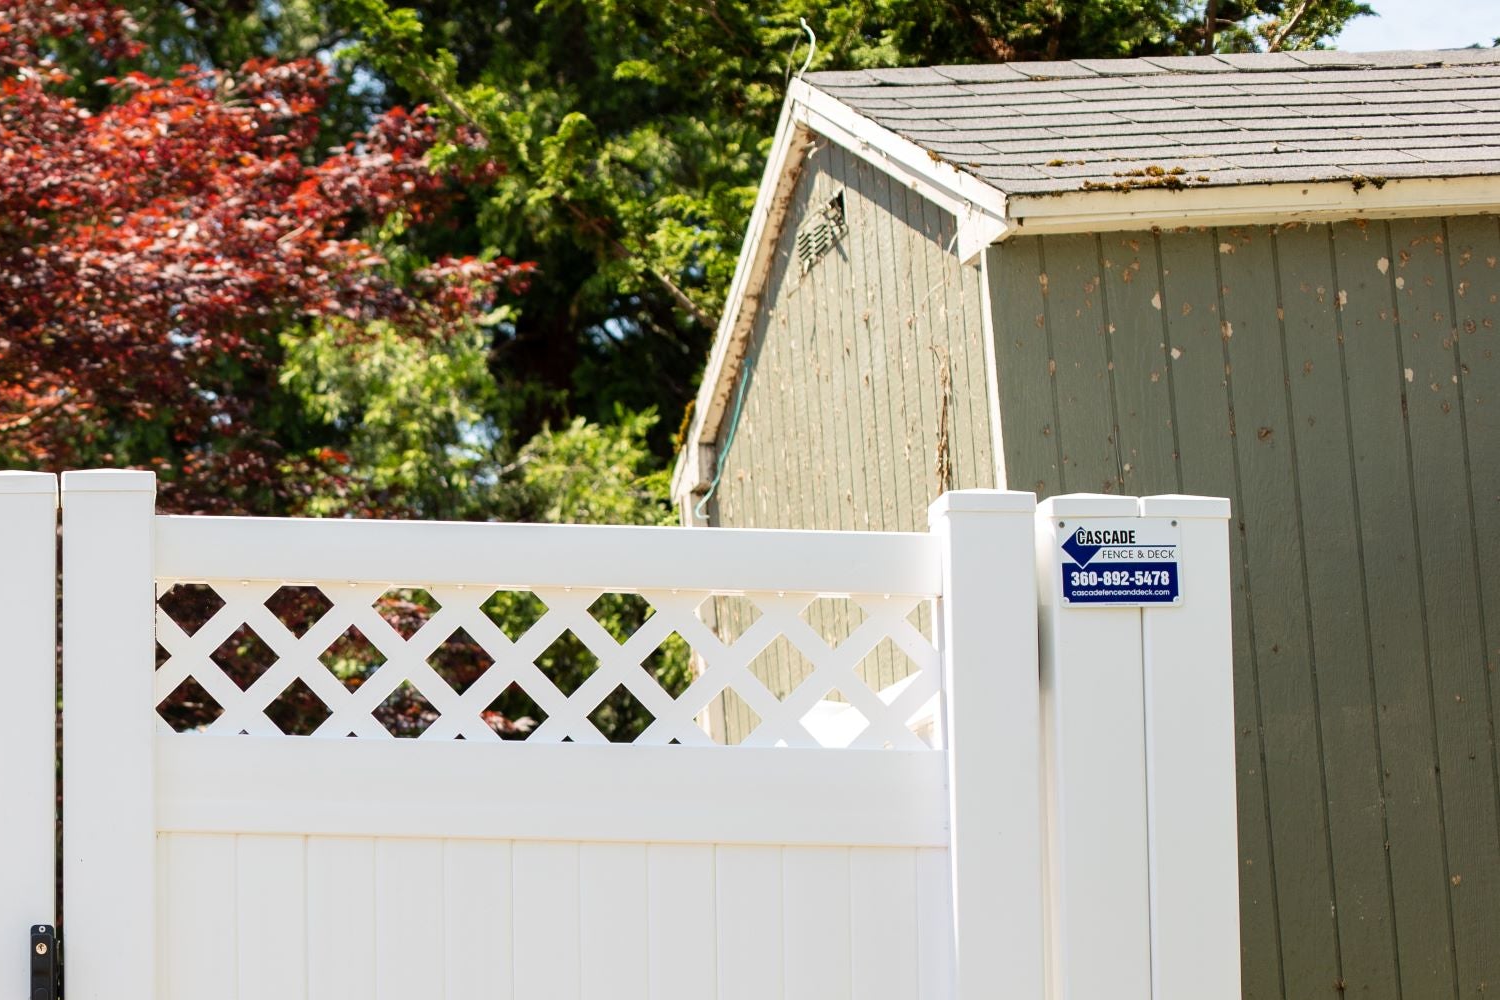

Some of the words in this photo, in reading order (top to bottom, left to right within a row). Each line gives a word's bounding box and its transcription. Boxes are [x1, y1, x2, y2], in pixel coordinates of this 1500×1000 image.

[1077, 530, 1136, 544] CASCADE
[1102, 550, 1134, 559] FENCE
[1137, 550, 1145, 559] &
[1148, 550, 1175, 559] DECK
[1071, 571, 1170, 586] 360-892-5478
[1071, 589, 1170, 597] cascadefenceanddeck.com
